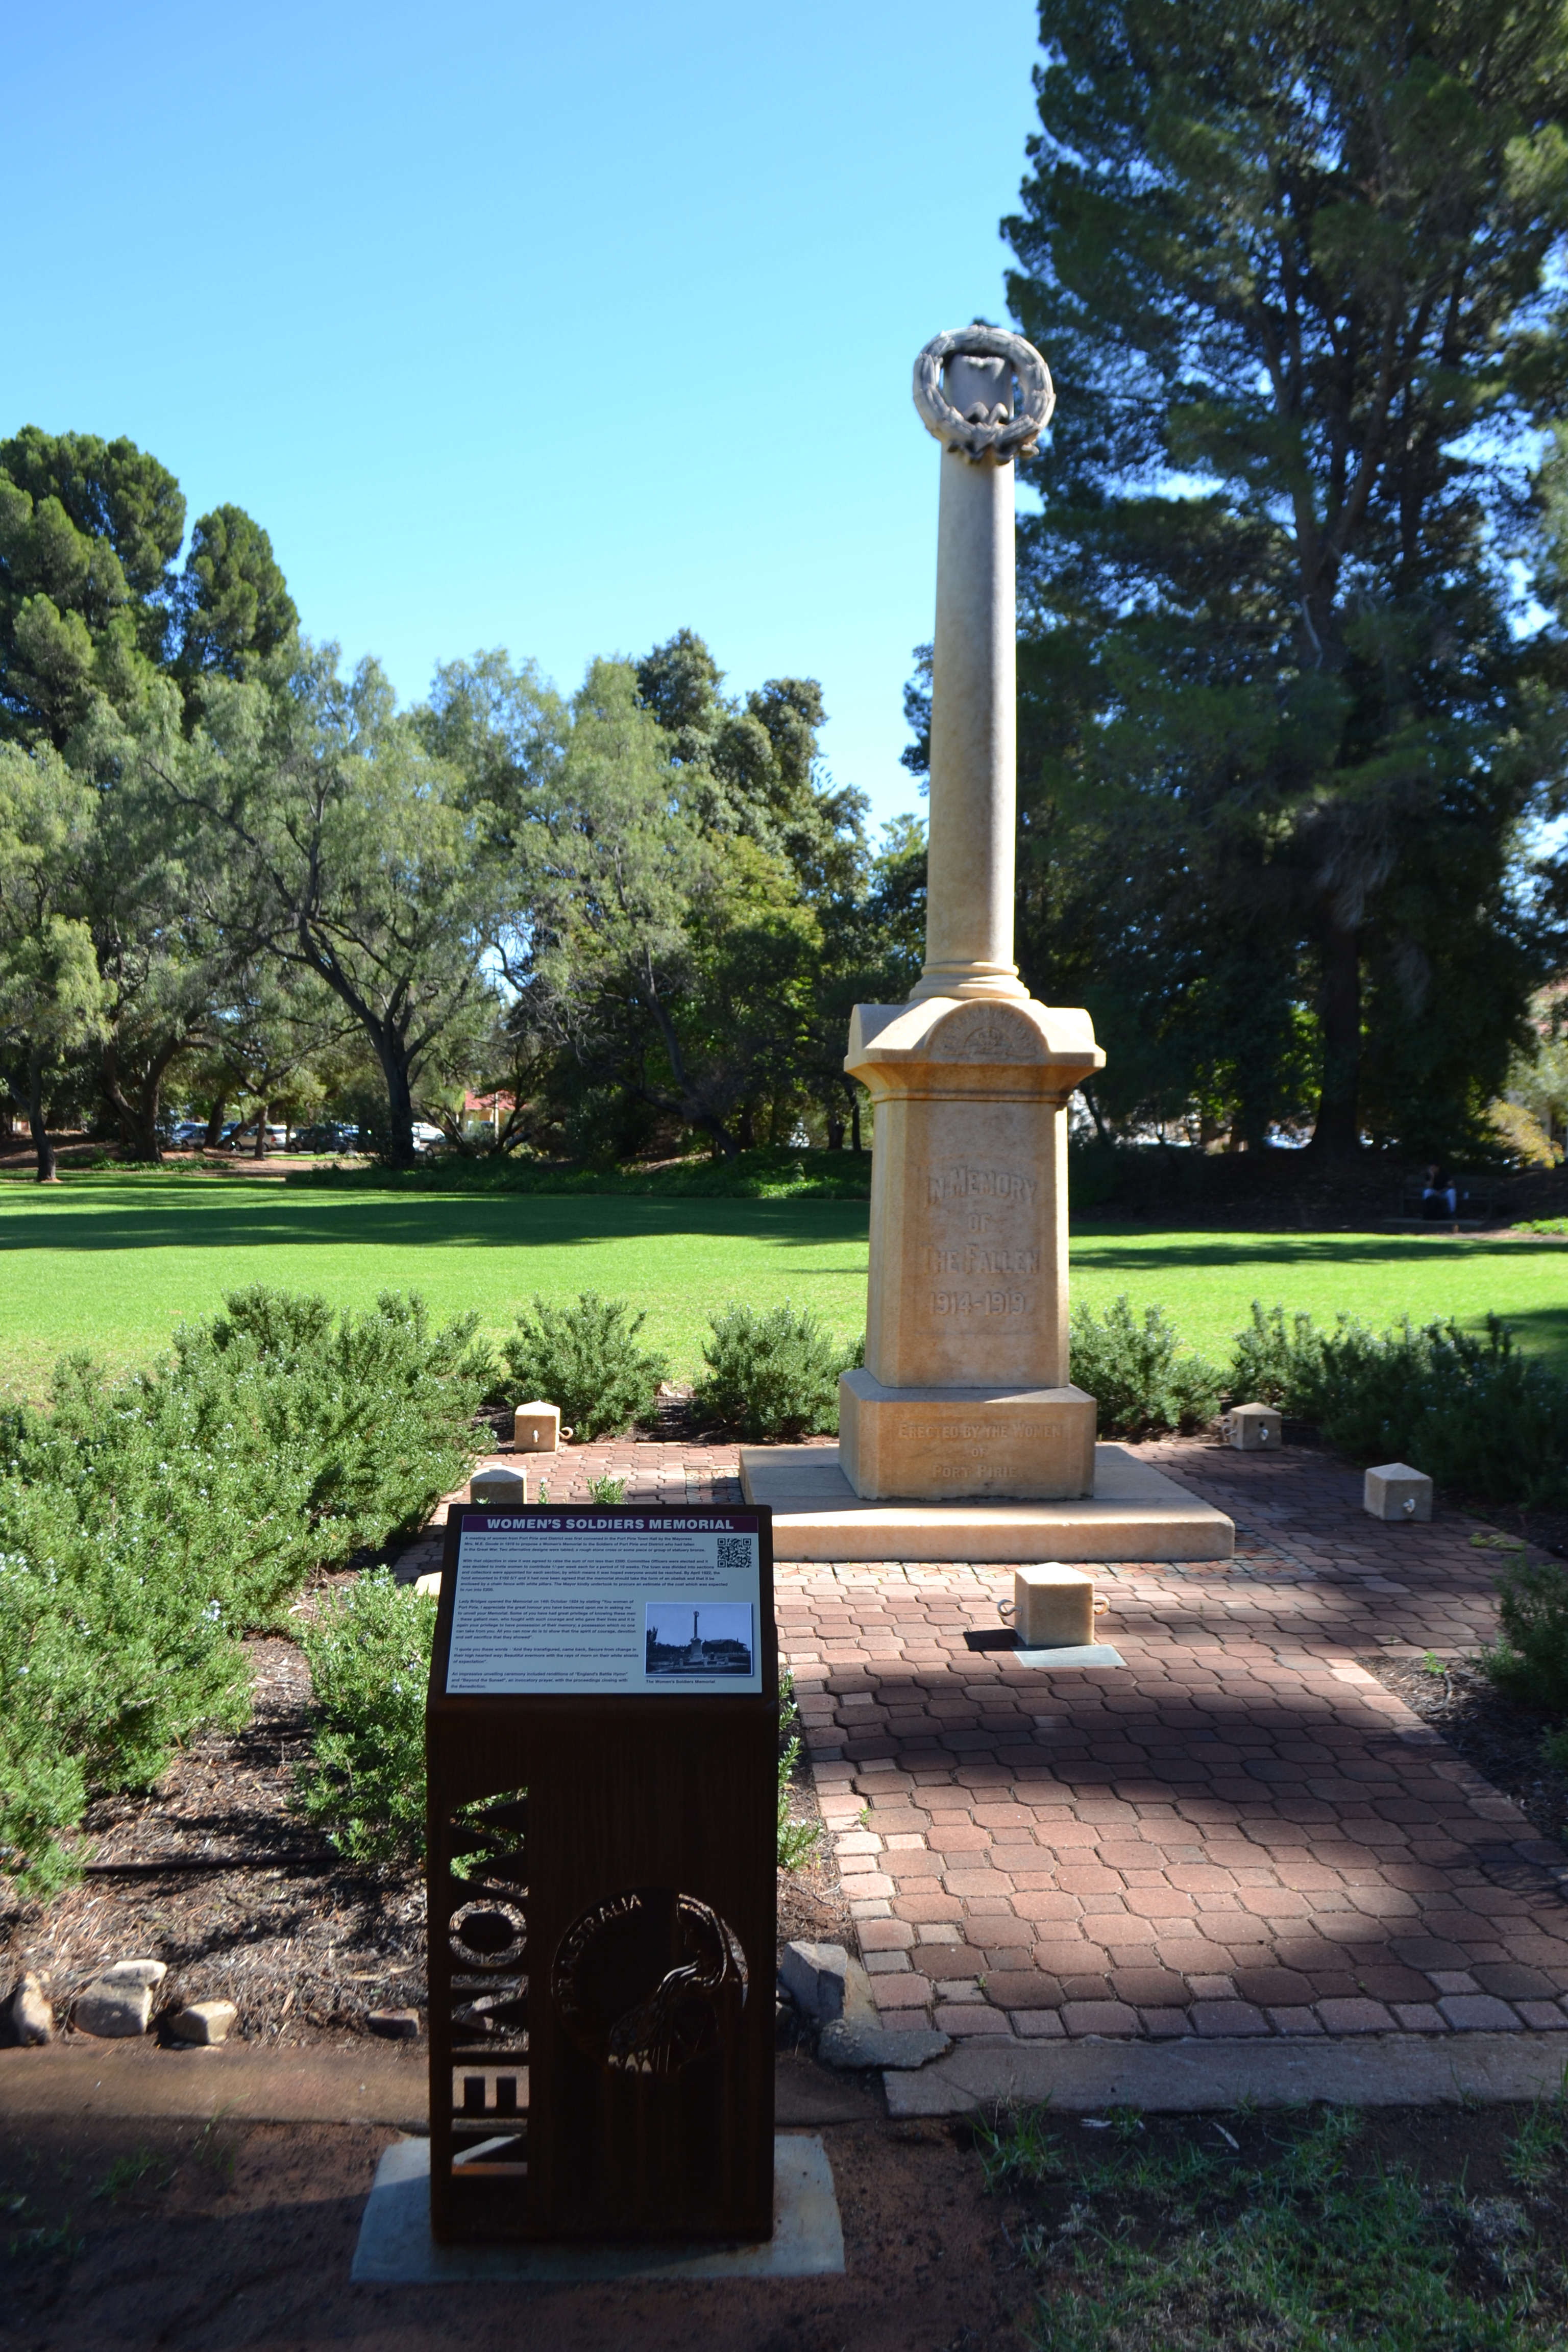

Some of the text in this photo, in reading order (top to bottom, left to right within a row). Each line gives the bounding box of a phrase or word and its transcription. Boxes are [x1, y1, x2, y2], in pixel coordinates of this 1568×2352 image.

[950, 1166, 1039, 1207] MEMORY
[967, 1212, 991, 1233] OF
[920, 1243, 1040, 1274] THE FALLEN
[929, 1291, 1025, 1315] 1914-1919
[898, 1423, 1061, 1438] ERECTED BY THE WOMEN
[971, 1447, 987, 1458] OF
[933, 1464, 970, 1478] PORT
[487, 1518, 733, 1529] WOMEN'S SOLDIERS MEMORIAL
[560, 1893, 643, 1974] AUSTRALIA
[450, 1786, 529, 2175] WOMEN
